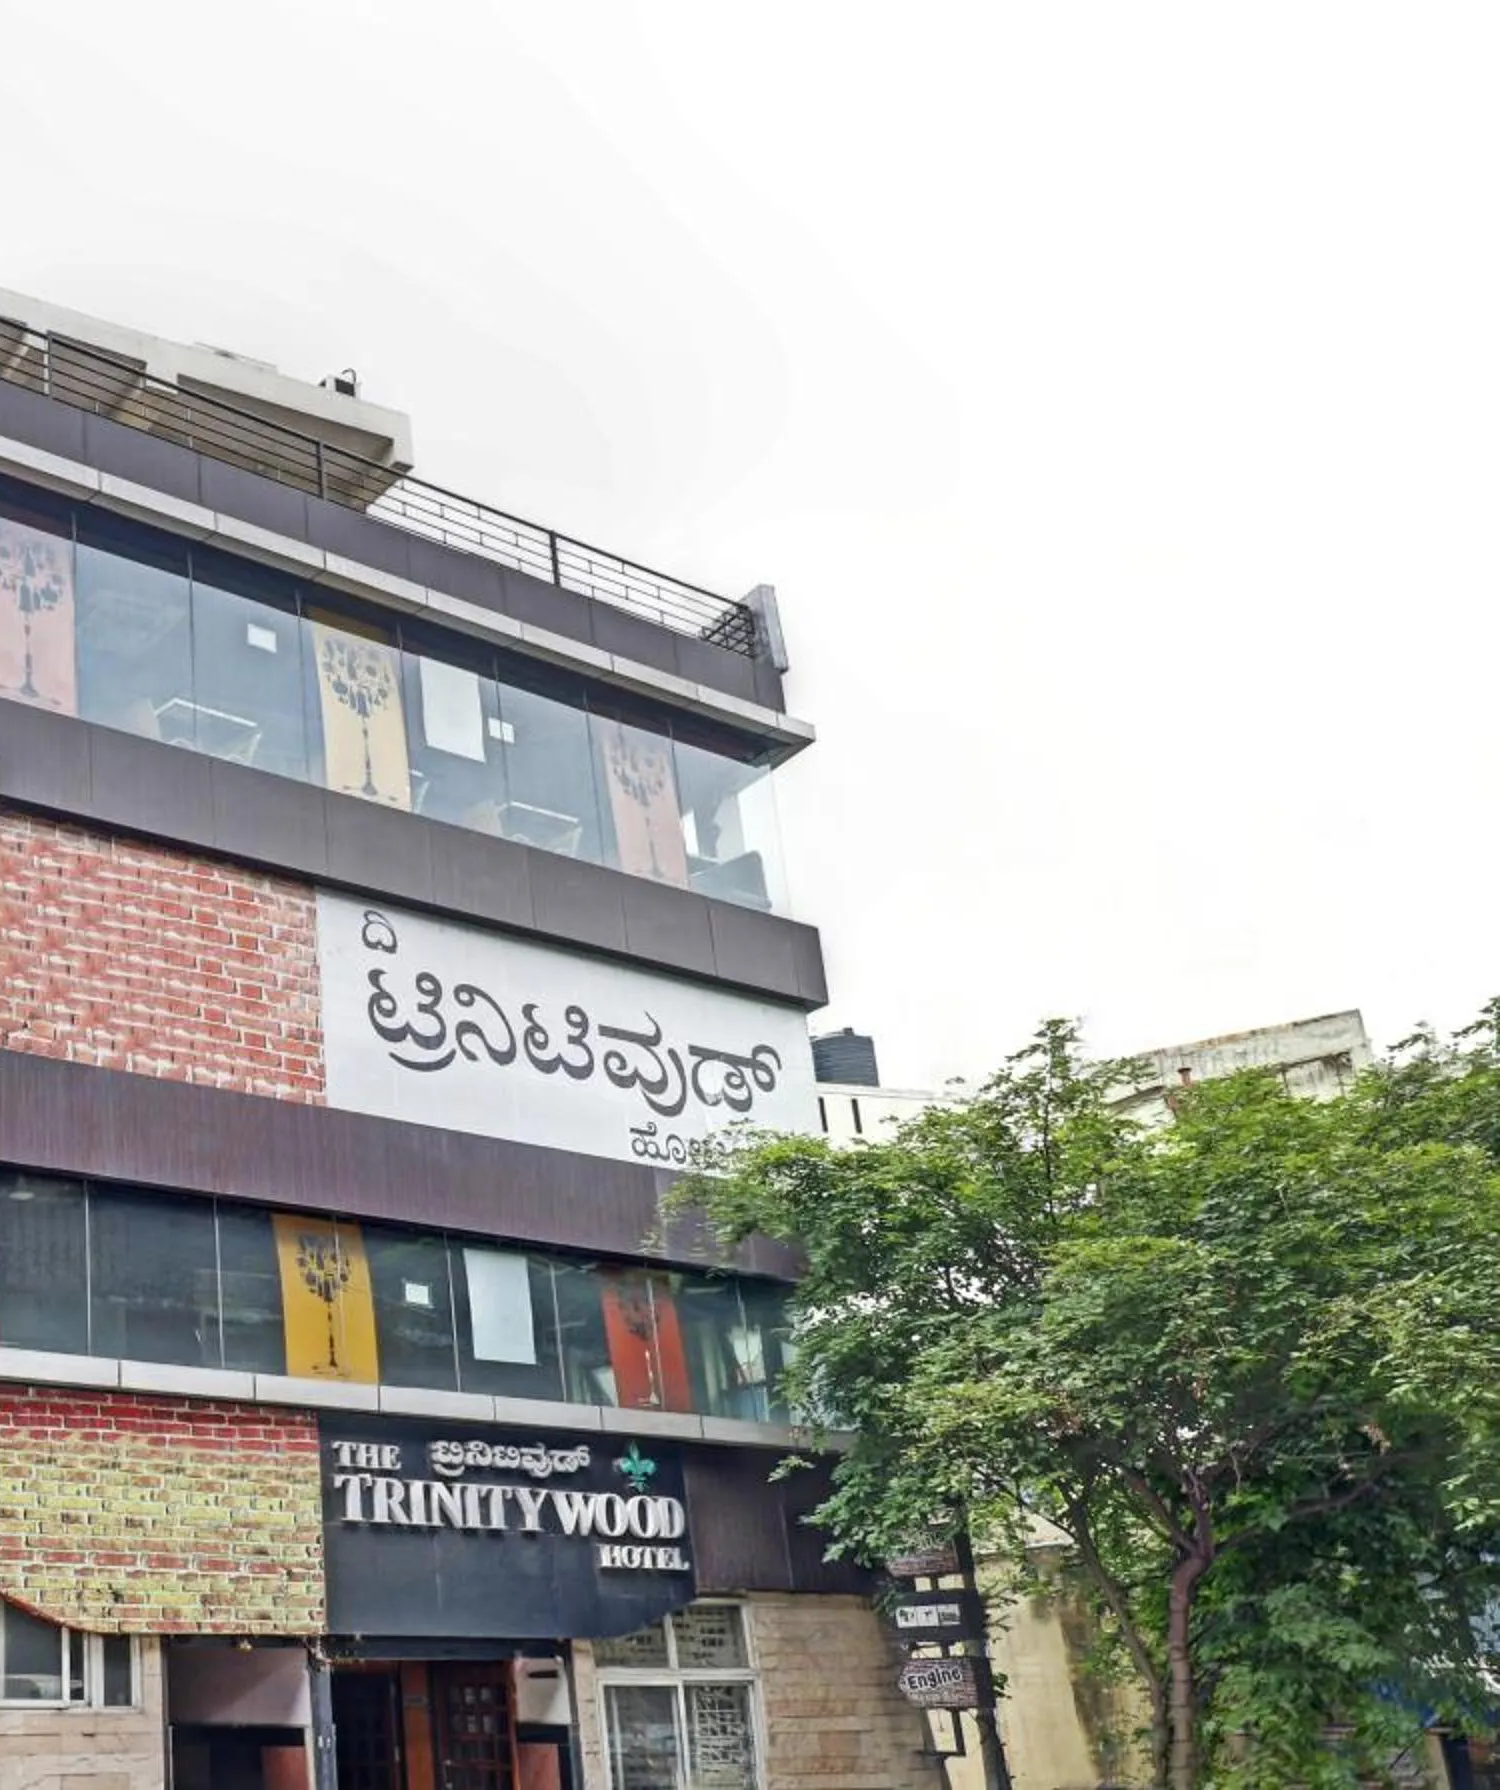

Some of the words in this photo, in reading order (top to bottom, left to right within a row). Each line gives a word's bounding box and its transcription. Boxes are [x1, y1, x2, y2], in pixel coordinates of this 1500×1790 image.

[361, 909, 398, 954] ದಿ
[332, 1440, 401, 1471] THE
[333, 1473, 685, 1540] TRINITYWOOD
[597, 1543, 689, 1571] HOTEL
